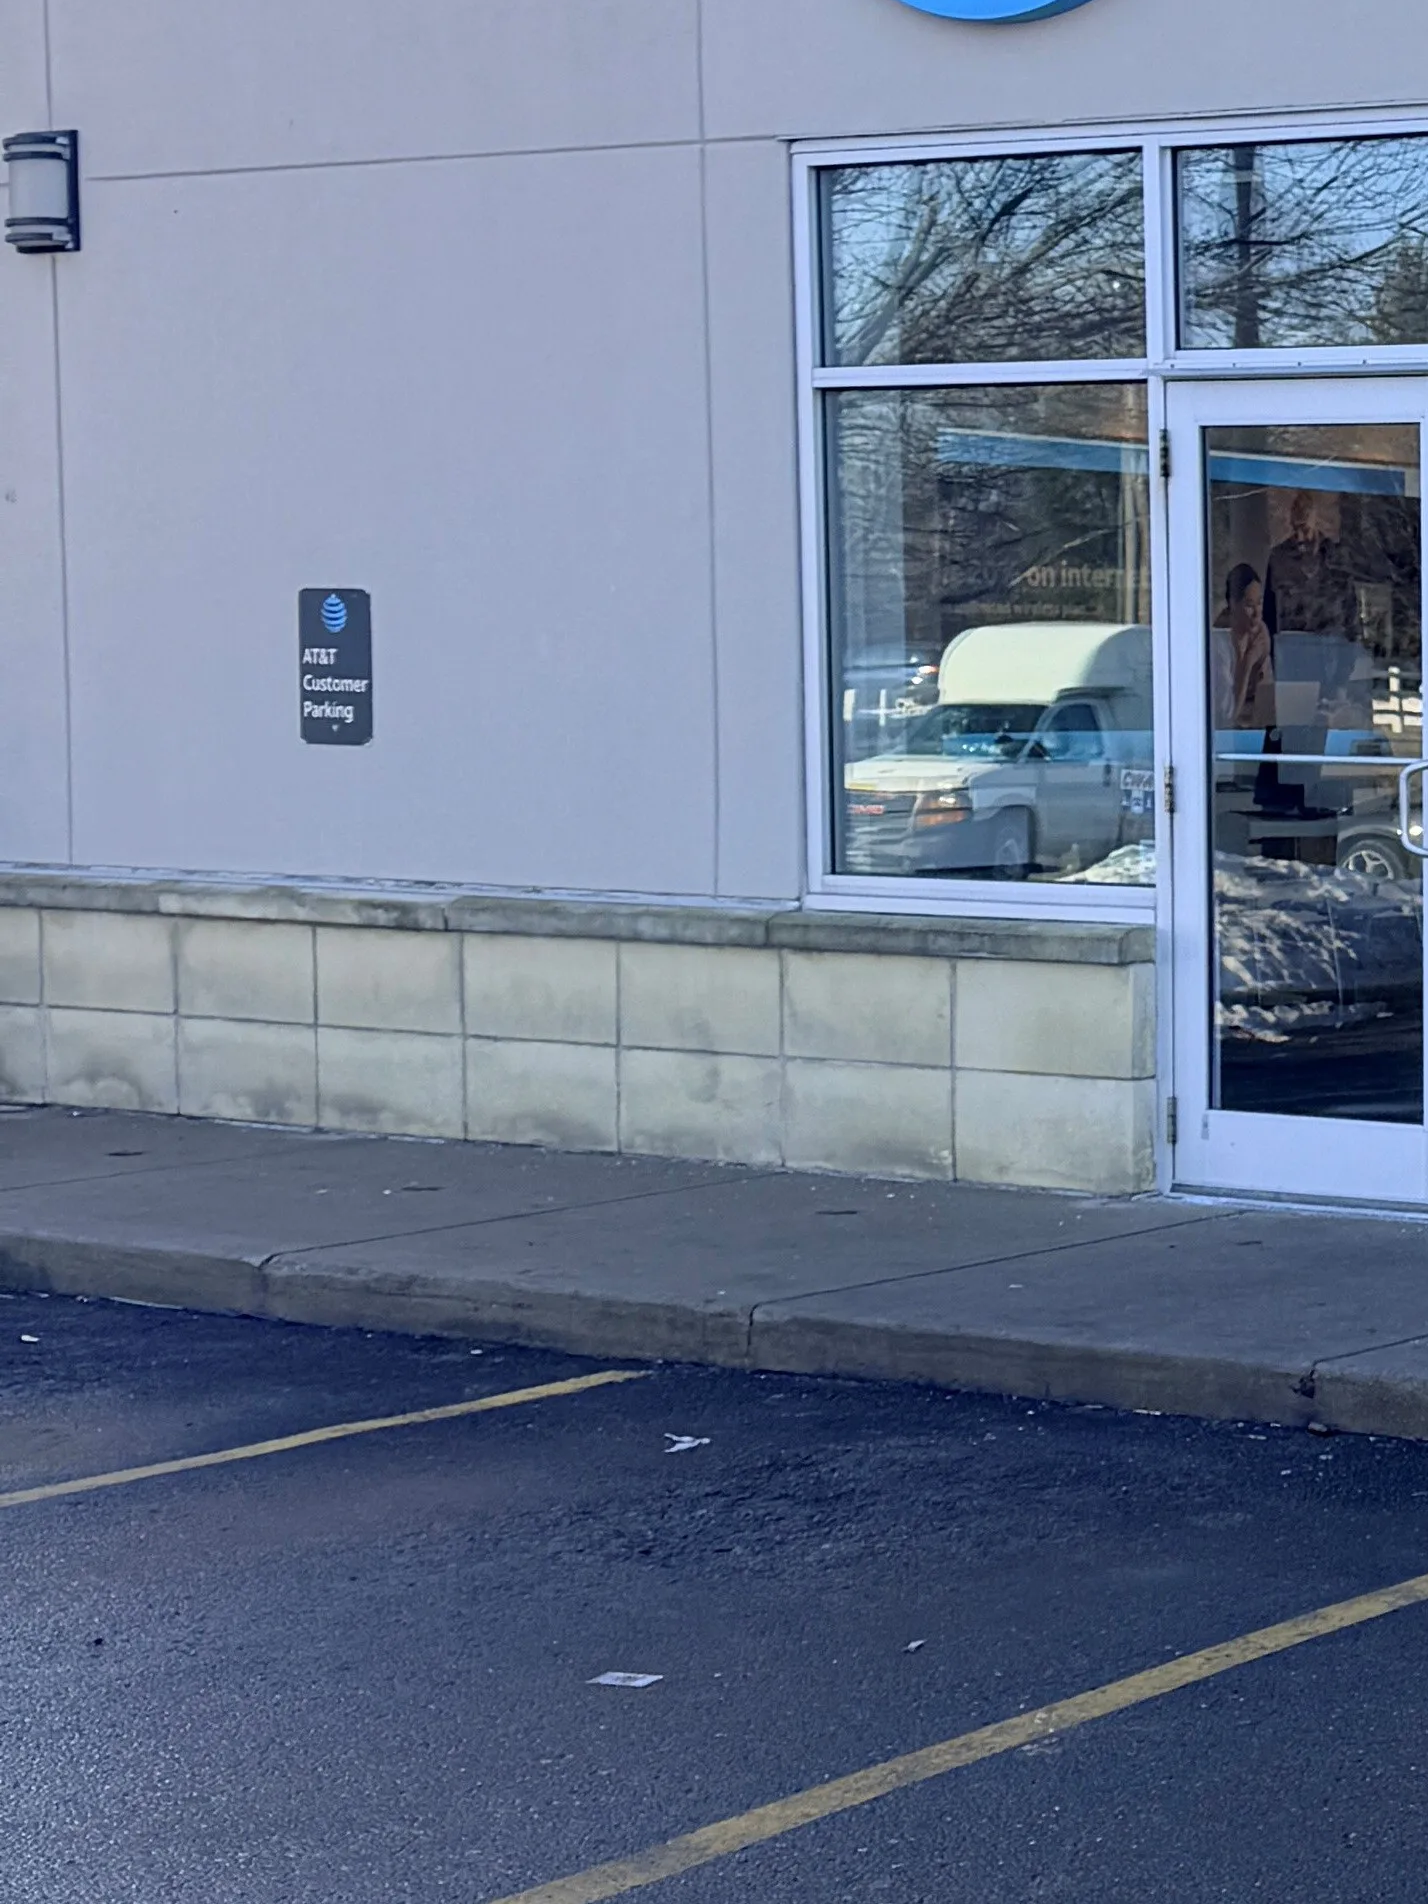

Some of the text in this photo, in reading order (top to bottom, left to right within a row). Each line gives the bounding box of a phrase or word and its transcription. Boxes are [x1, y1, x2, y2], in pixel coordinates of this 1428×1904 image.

[302, 648, 338, 665] AT&T
[302, 674, 369, 693] Customer
[303, 700, 354, 723] Parking
